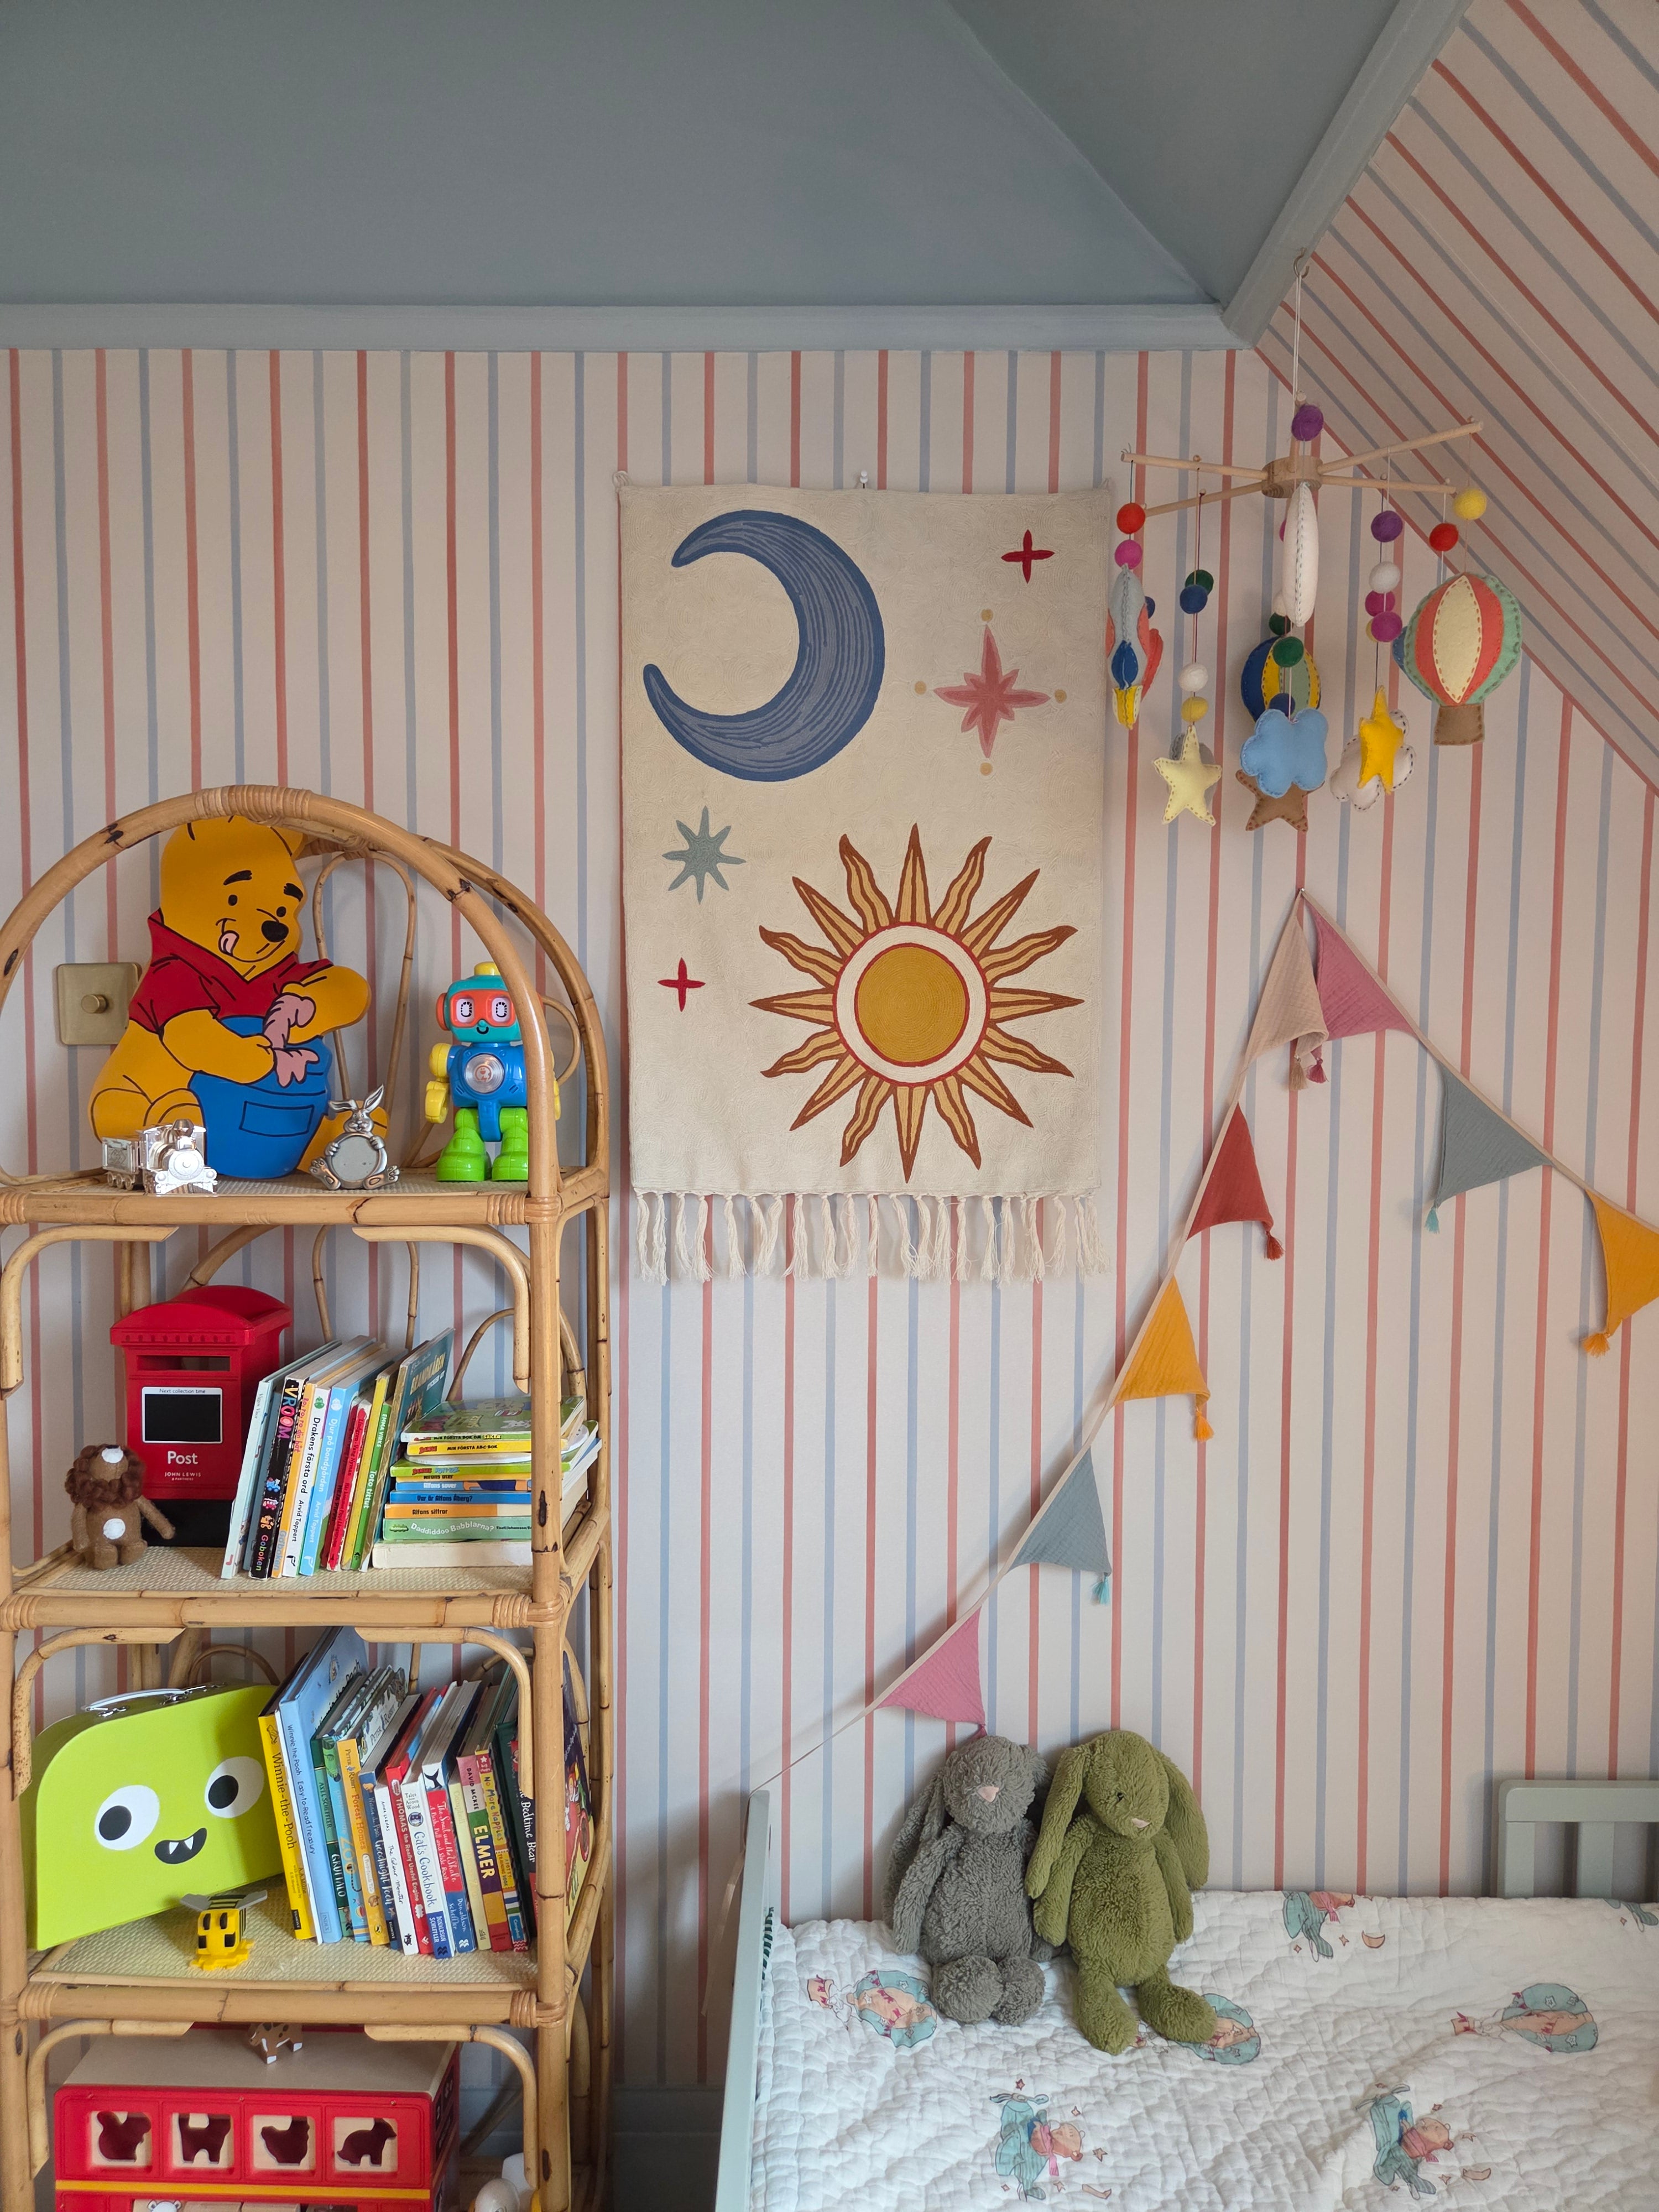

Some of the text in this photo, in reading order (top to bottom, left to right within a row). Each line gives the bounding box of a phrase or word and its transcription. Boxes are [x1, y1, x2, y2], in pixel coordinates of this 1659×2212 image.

[277, 1387, 299, 1439] VROOM
[298, 1420, 305, 1428] ro
[328, 1418, 338, 1434] Djur
[294, 1439, 302, 1453] båt
[309, 1417, 321, 1451] Drakens
[326, 1435, 334, 1446] på
[168, 1451, 198, 1464] Post
[304, 1453, 315, 1477] första
[319, 1447, 332, 1492] bondgården
[363, 1470, 377, 1509] Toto tittut
[453, 1494, 473, 1503] Åberg?
[292, 1517, 301, 1542] Tappert
[310, 1517, 319, 1543] Tappert
[411, 1522, 449, 1535] Daddiddoo
[450, 1521, 494, 1532] Babblarna?
[255, 1535, 268, 1571] Goboken
[272, 1752, 298, 1849] Winnie-the-Pooh
[287, 1724, 296, 1747] Winnie
[306, 1824, 316, 1854] Treasury
[471, 1789, 479, 1810] MCKEE
[322, 1798, 332, 1828] SCHEFFLER
[352, 1794, 362, 1820] Forest
[396, 1797, 408, 1832] THOMAS
[437, 1801, 448, 1815] The
[484, 1777, 503, 1841] No More Nappies
[521, 1801, 535, 1838] Bedtime
[356, 1822, 366, 1850] Homes
[439, 1816, 451, 1833] Snail
[473, 1825, 495, 1879] ELMER
[526, 1841, 536, 1863] Bear
[332, 1854, 346, 1897] GRUFFALO
[375, 1839, 389, 1884] Goodnight
[382, 1886, 393, 1905] Pooh
[414, 1832, 437, 1907] Cat's Cookbook
[447, 1855, 460, 1882] Whale
[395, 1880, 404, 1905] Monster
[449, 1903, 460, 1930] Scheffler
[457, 1898, 467, 1932] Donaldson
[429, 1917, 439, 1943] SCHEFFLER
[436, 1916, 446, 1942] DONALDSON
